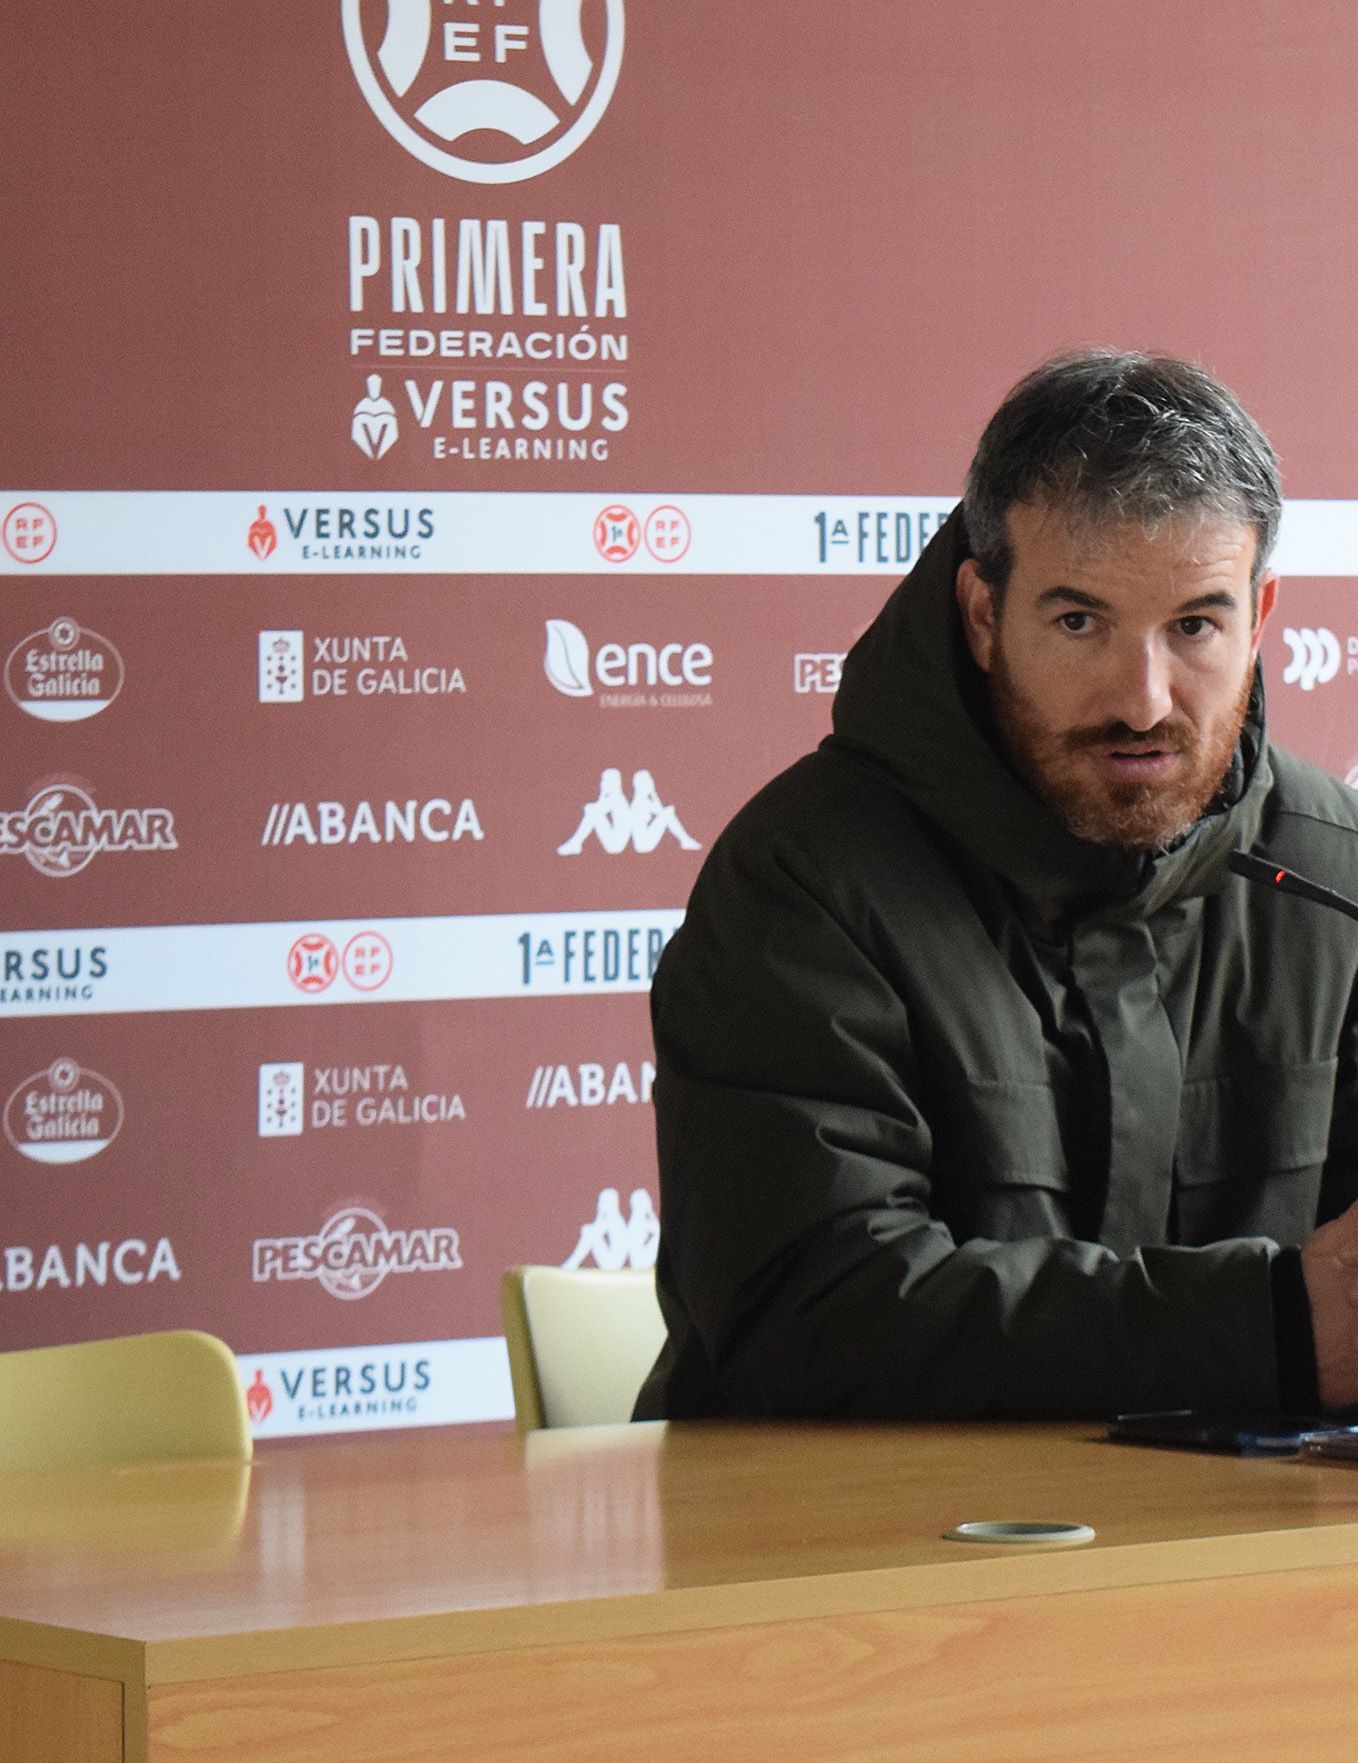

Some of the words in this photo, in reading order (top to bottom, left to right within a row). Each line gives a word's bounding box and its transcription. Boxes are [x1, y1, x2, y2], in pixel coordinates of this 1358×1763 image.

[349, 215, 628, 318] PRIMERA
[350, 325, 628, 361] FEDERACIÓN
[404, 379, 629, 432] VERSUS
[433, 436, 608, 461] E-LEARNING
[284, 508, 434, 539] VERSUS
[302, 545, 421, 560] E-LEARNING
[26, 649, 103, 672] Estrella
[314, 636, 408, 663] XUNTA
[595, 642, 714, 686] ence
[28, 673, 100, 697] Galicia
[312, 668, 348, 695] DE
[356, 667, 466, 695] GALICIA
[0, 807, 178, 853] SCAMAR
[314, 1064, 408, 1094] XUNTA
[311, 1099, 347, 1128] DE
[355, 1093, 466, 1126] GALICIA
[0, 1237, 181, 1292] BANCA
[252, 1228, 463, 1282] PESCAMAR
[281, 1358, 431, 1400] VERSUS
